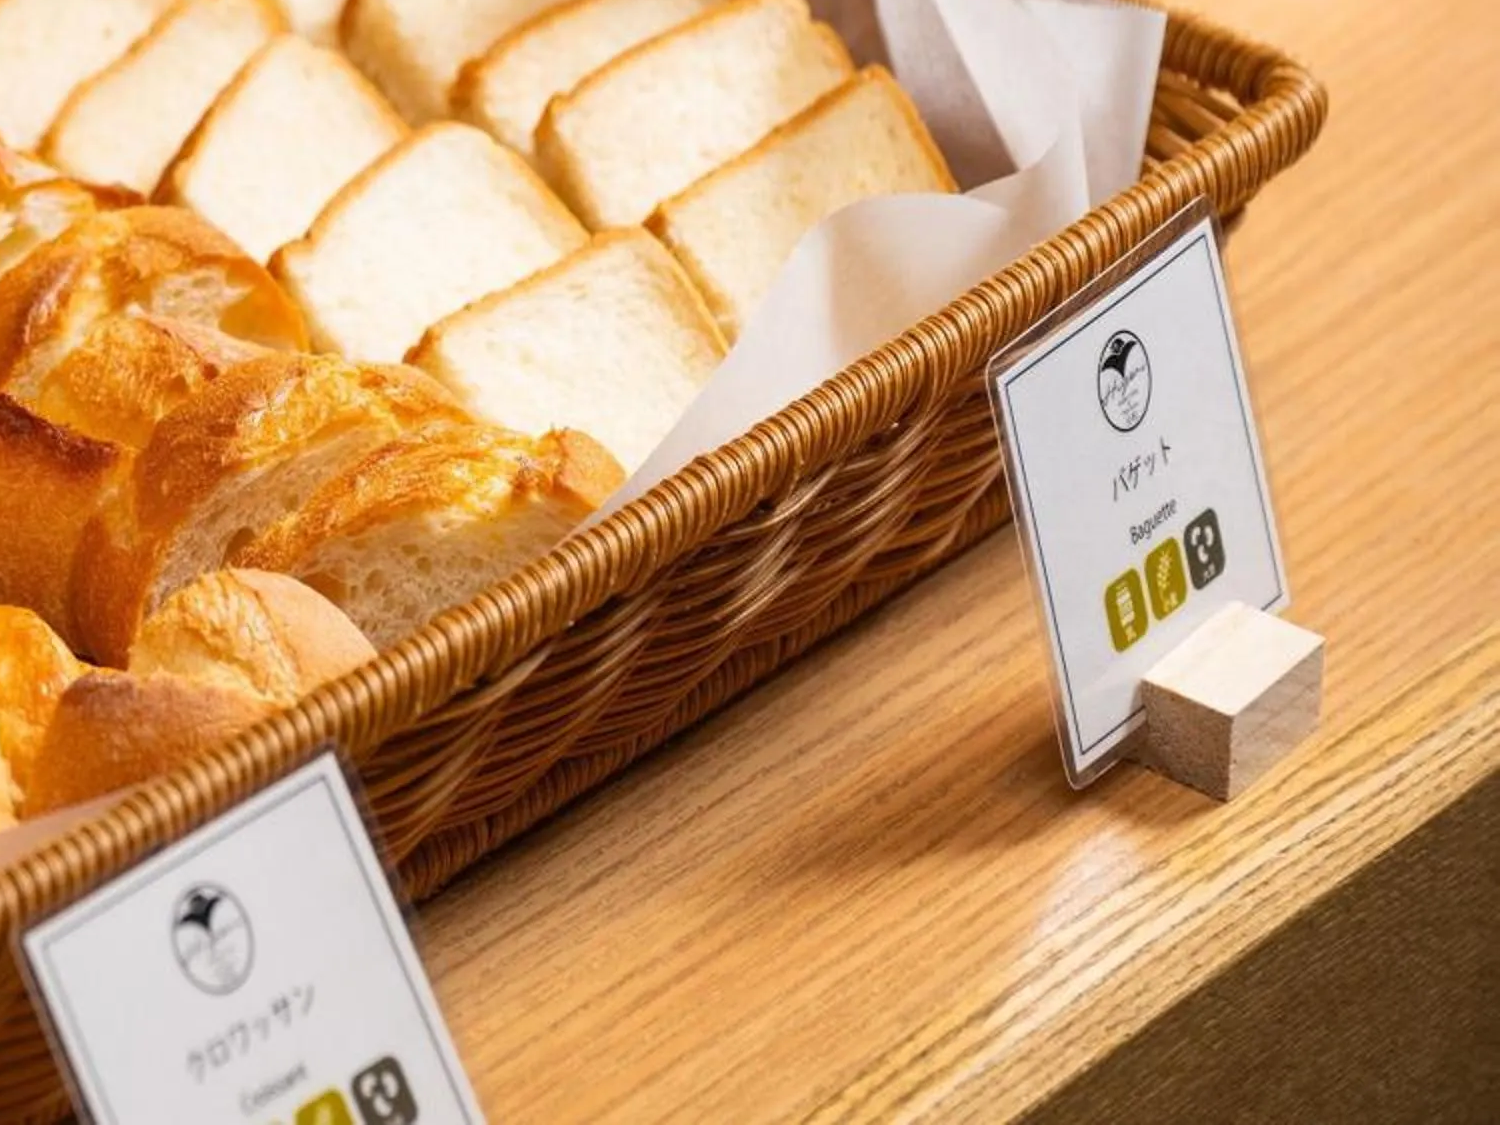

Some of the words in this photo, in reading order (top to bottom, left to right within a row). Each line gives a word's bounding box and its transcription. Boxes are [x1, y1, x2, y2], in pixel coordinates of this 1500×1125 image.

[1113, 436, 1172, 502] バゲット
[1129, 498, 1178, 545] Baguette
[186, 983, 316, 1084] クロワッサン
